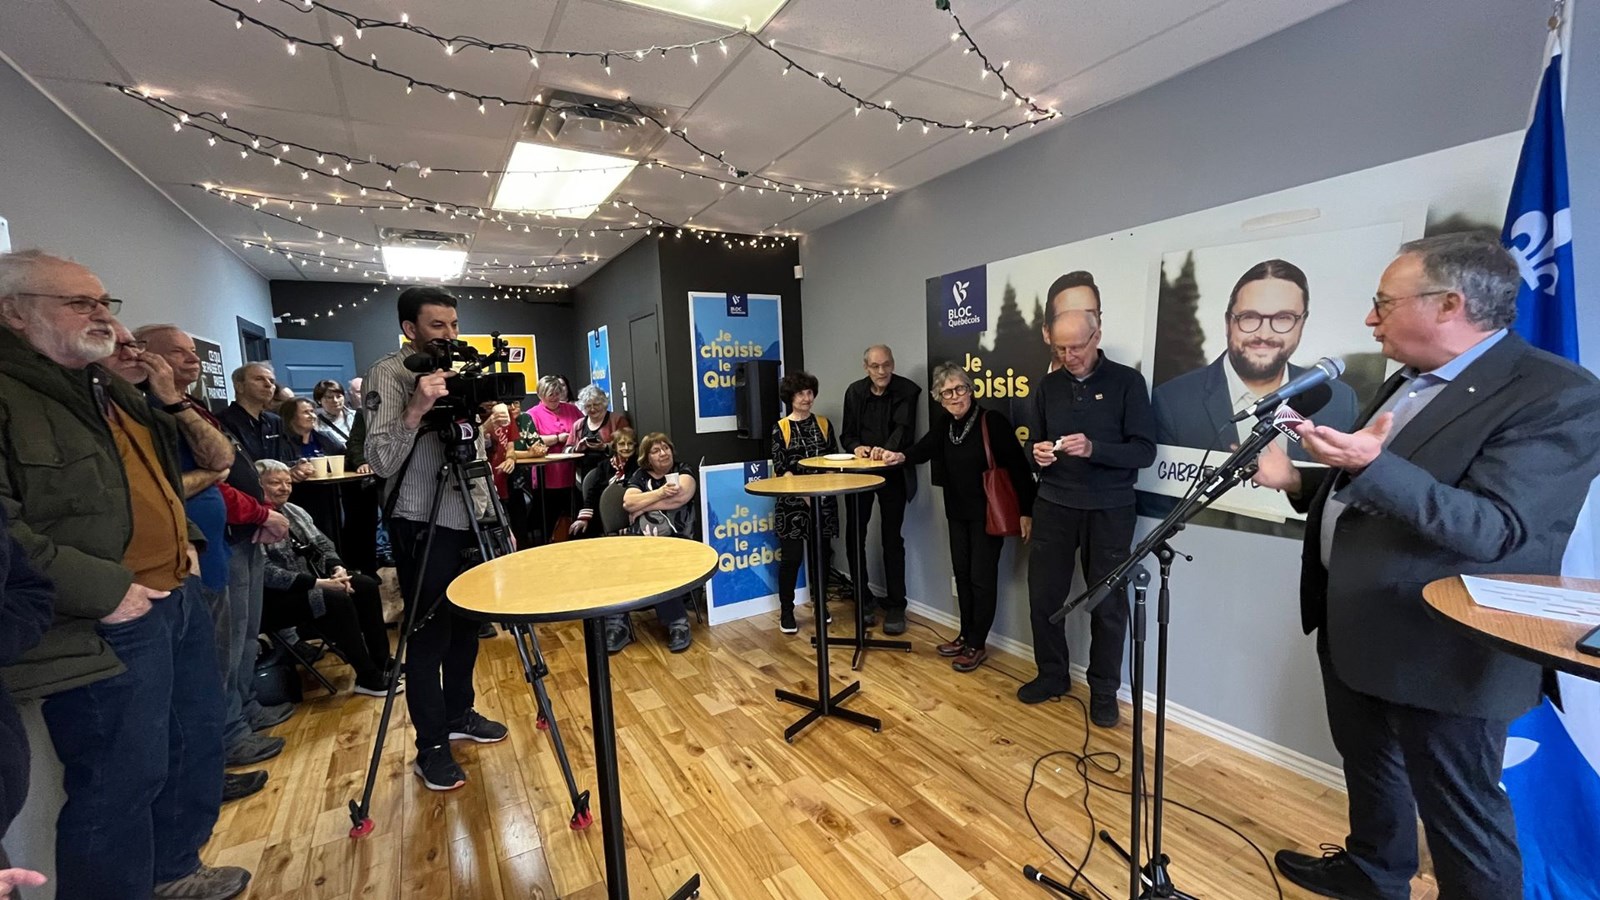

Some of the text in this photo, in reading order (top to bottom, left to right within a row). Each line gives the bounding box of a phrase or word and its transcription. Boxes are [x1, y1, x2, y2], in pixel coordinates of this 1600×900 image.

[948, 305, 972, 319] BLOC
[948, 315, 980, 328] Québécois
[716, 330, 731, 342] Je
[700, 340, 763, 358] choisis
[719, 360, 731, 371] le
[962, 352, 982, 373] Je
[973, 368, 1030, 398] oisis
[1280, 423, 1301, 441] TVRM
[1157, 460, 1220, 482] GABR
[732, 505, 749, 518] Je
[714, 512, 776, 539] choisi
[735, 538, 748, 552] le
[719, 547, 782, 572] Québe
